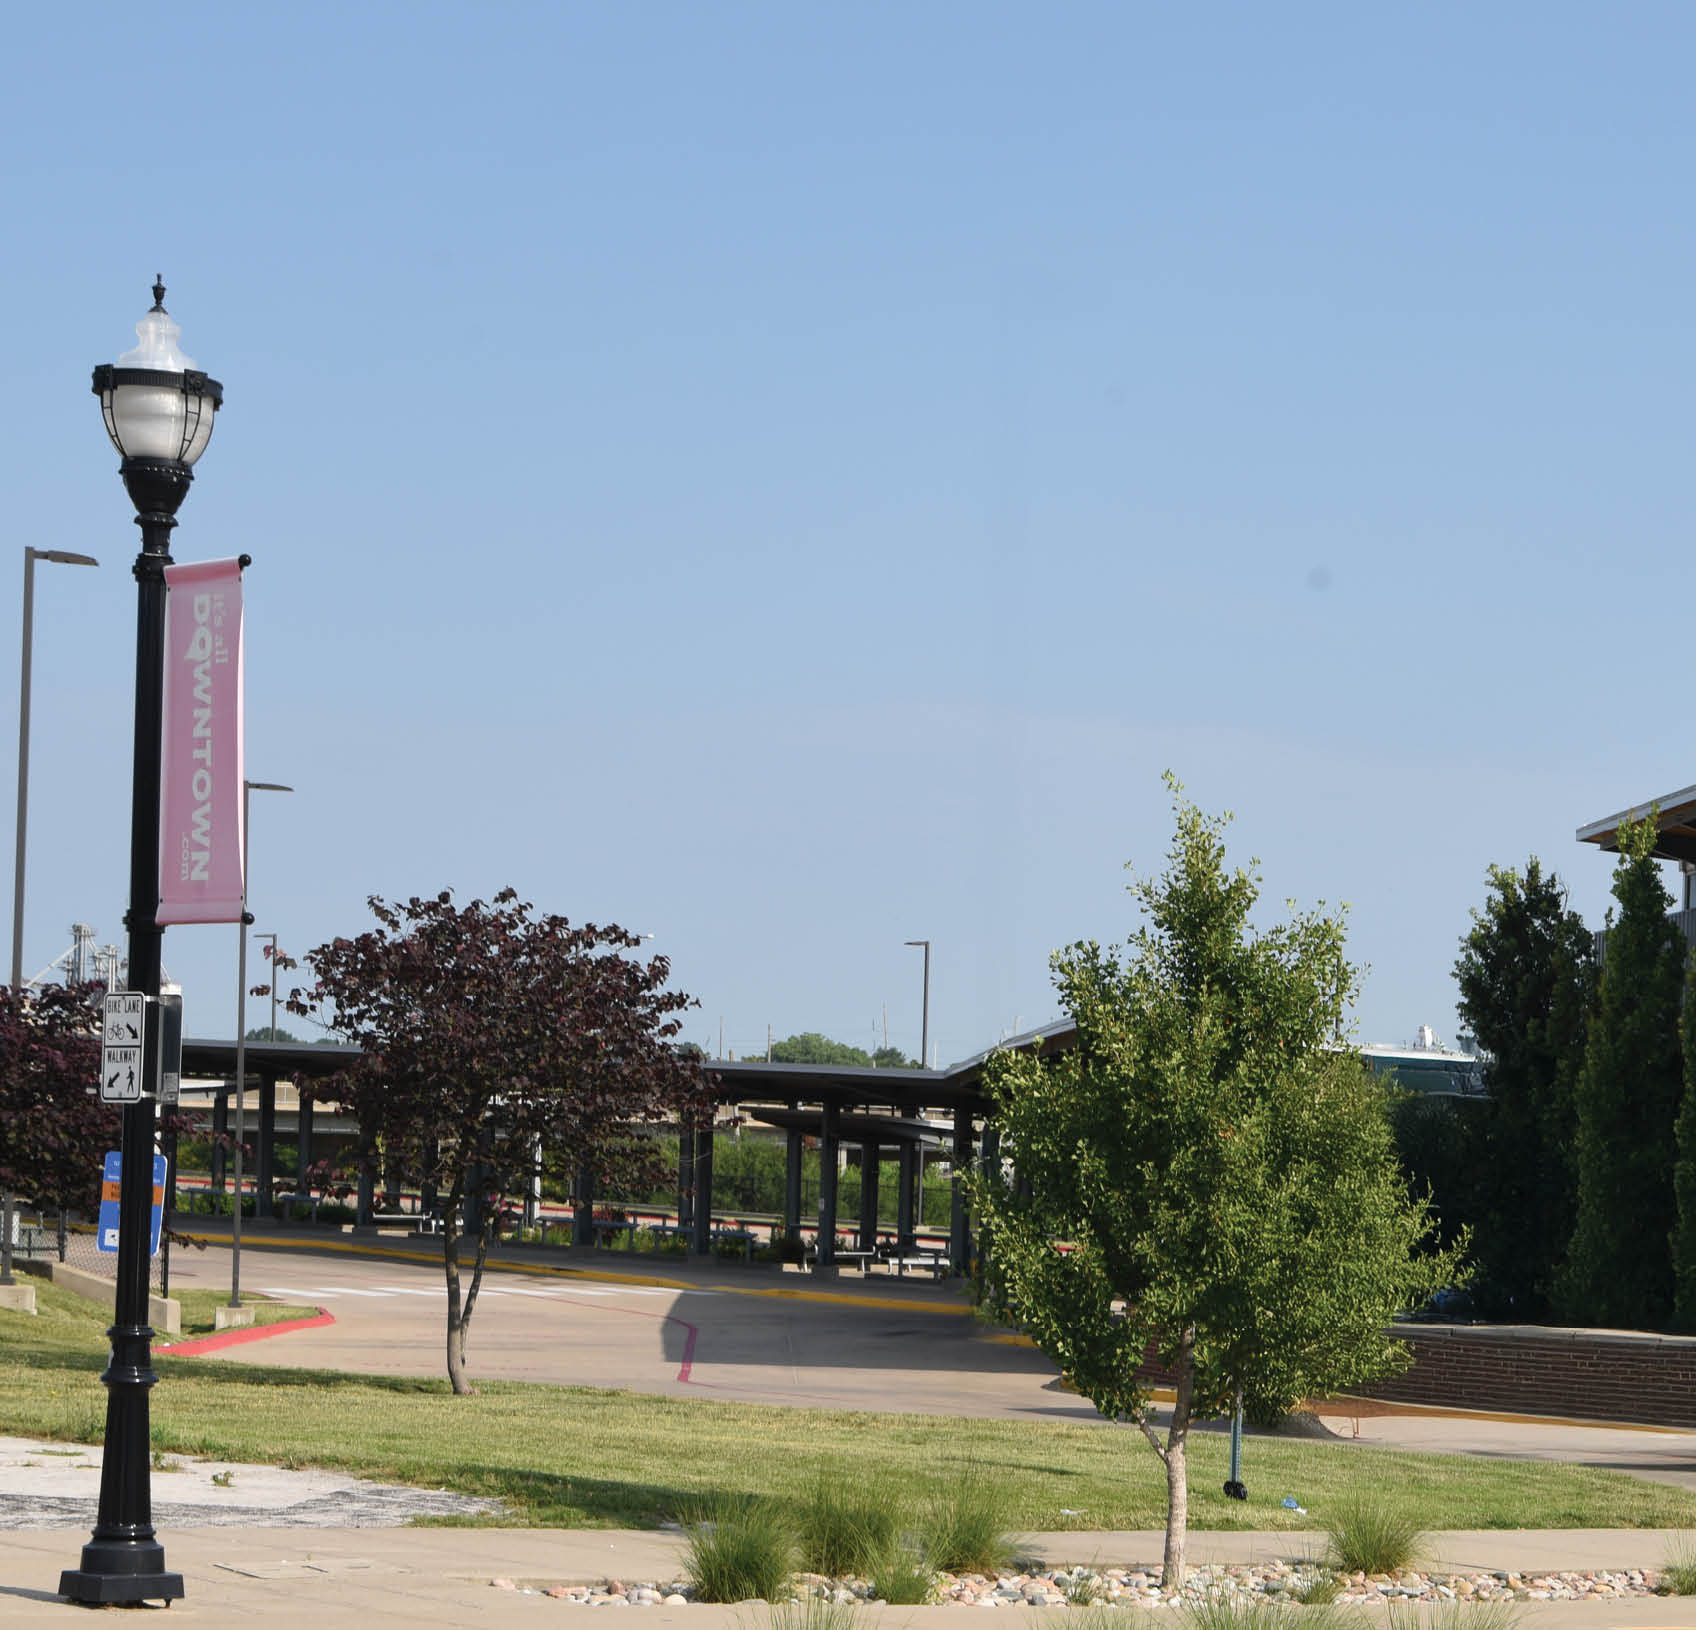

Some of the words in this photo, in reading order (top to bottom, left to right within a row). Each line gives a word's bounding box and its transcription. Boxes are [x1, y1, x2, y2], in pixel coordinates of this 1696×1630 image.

[213, 593, 227, 627] it's
[215, 635, 228, 664] all
[183, 593, 213, 881] DOWNTOWN
[107, 999, 121, 1014] BIKE
[124, 999, 140, 1014] LANE
[107, 1050, 137, 1064] WALKWAY
